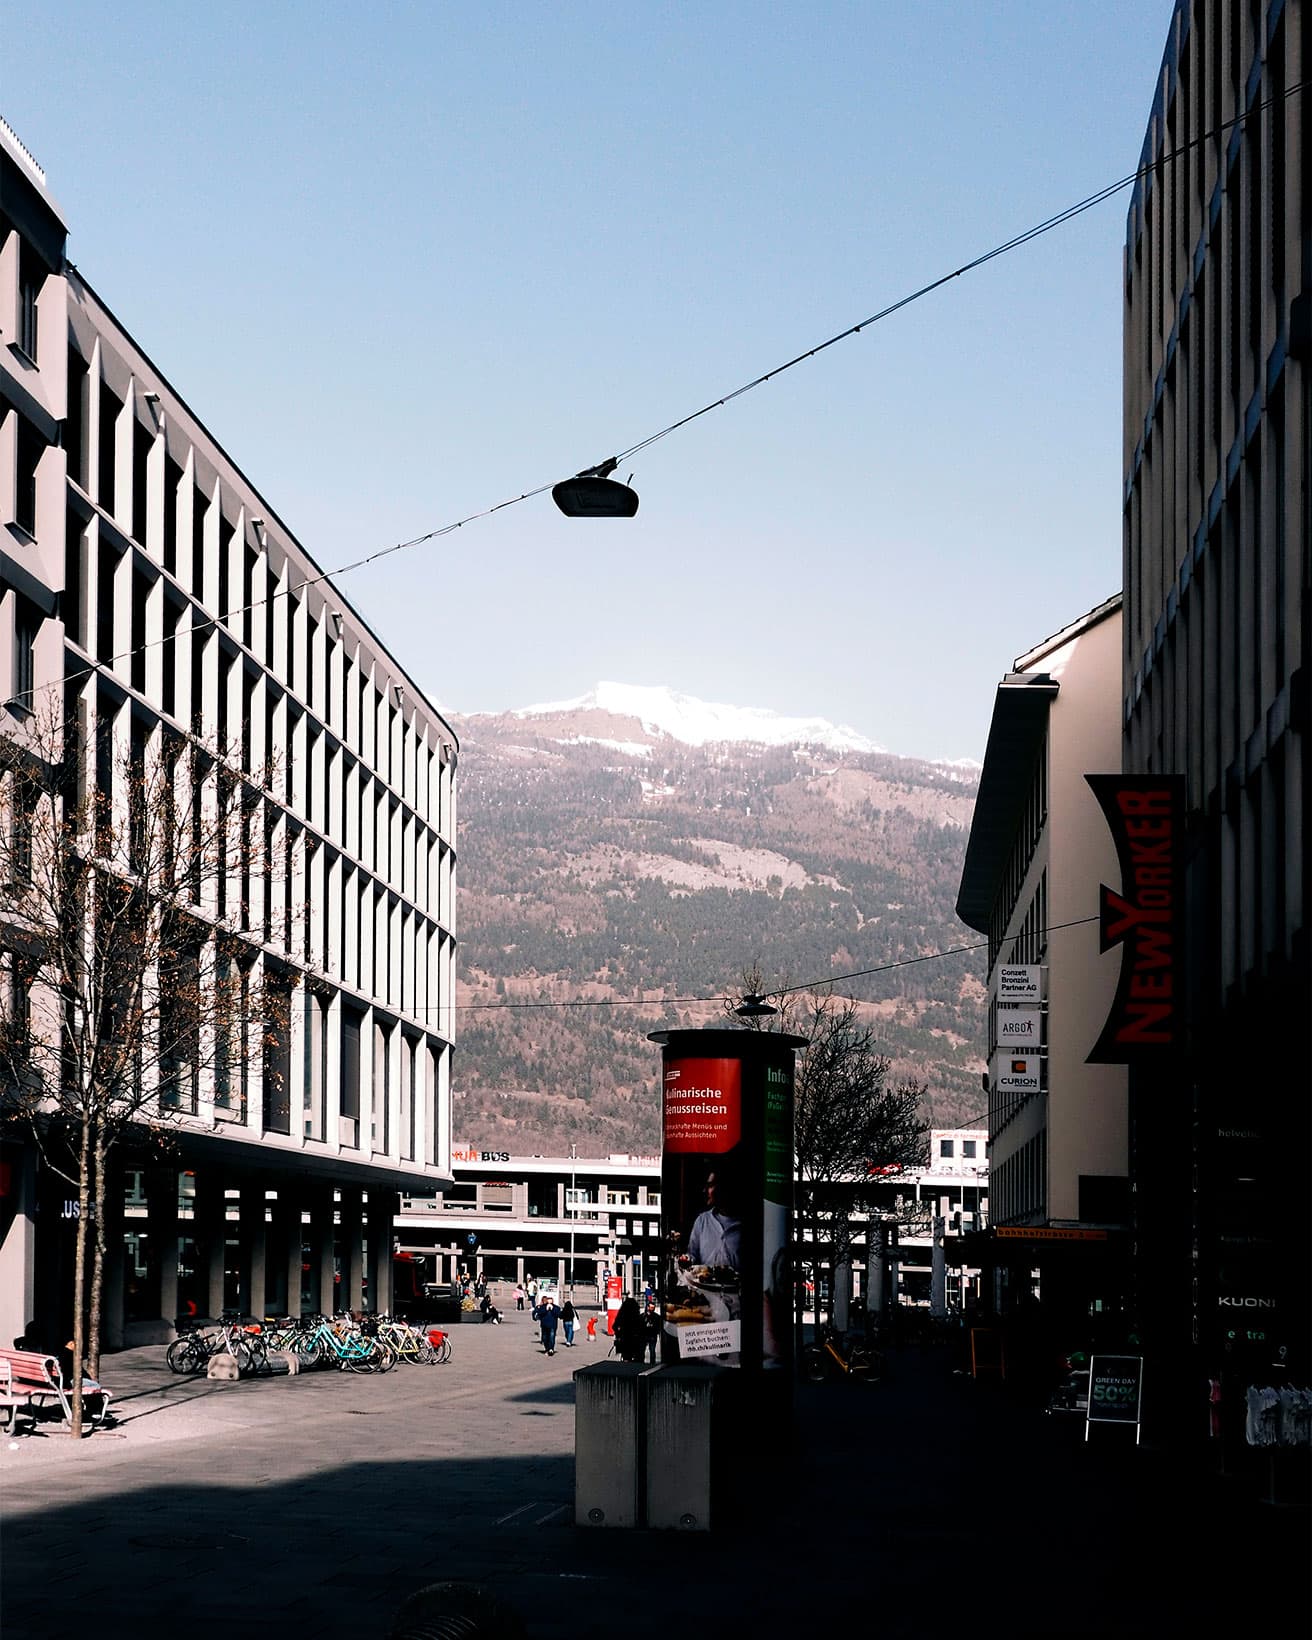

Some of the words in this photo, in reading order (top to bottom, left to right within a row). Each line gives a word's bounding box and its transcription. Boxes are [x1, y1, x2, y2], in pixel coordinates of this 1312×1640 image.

[1002, 1023, 1026, 1033] ARGO
[1001, 1077, 1038, 1085] CURION
[714, 1123, 728, 1131] und
[481, 1151, 510, 1162] BUS
[1218, 1296, 1276, 1308] KUONI
[1093, 1384, 1137, 1403] 50%
